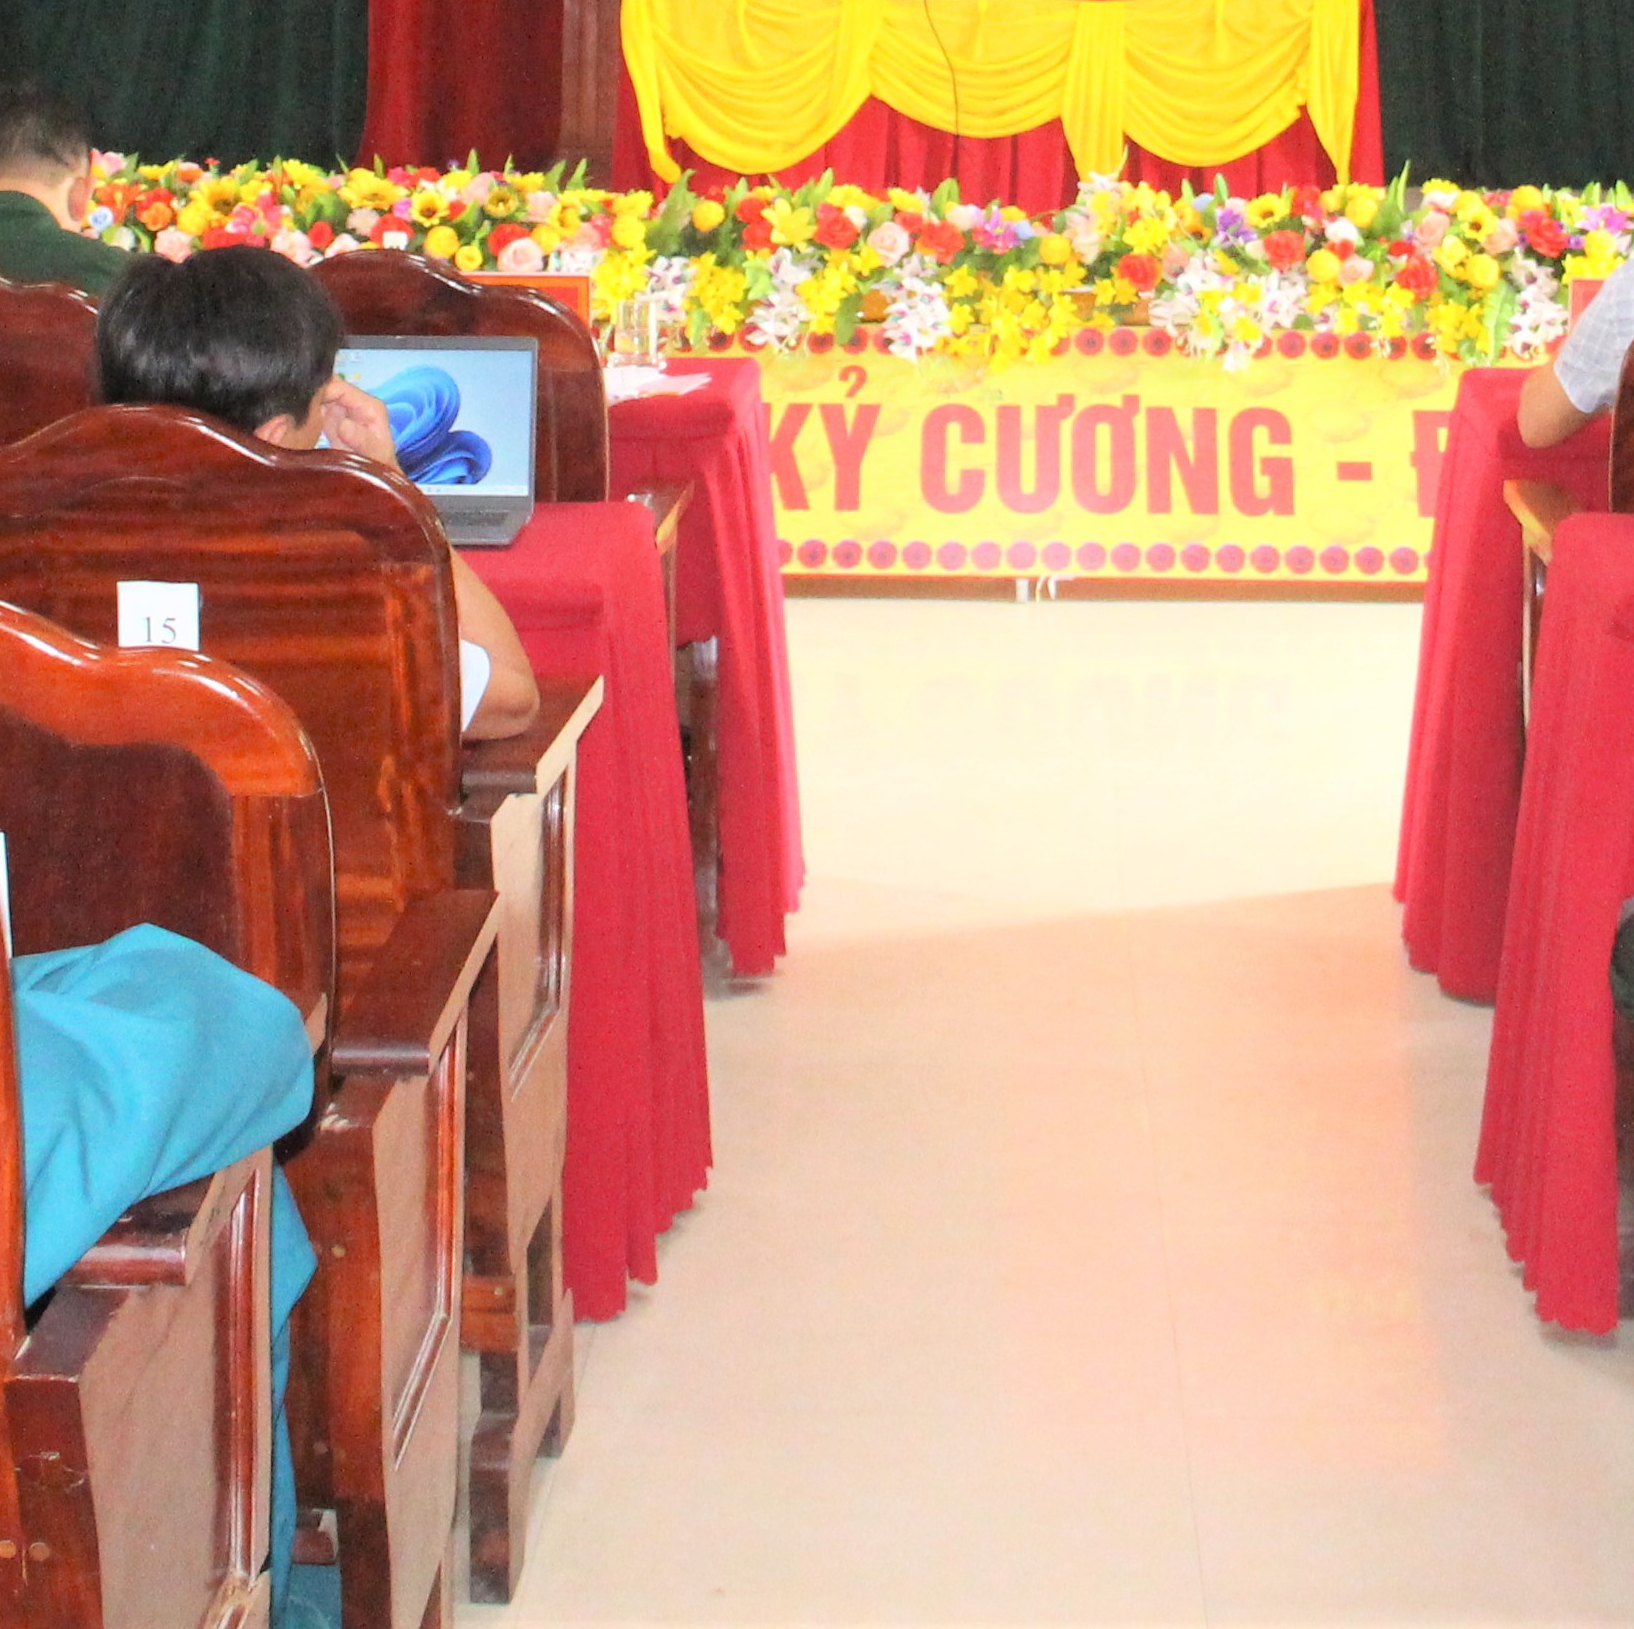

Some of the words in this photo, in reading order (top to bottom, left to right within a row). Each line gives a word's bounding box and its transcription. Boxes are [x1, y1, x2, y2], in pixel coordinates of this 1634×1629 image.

[763, 365, 883, 511] KỶ
[920, 393, 1295, 516] CƯƠNG
[1336, 461, 1372, 481] -
[145, 616, 177, 644] 15
